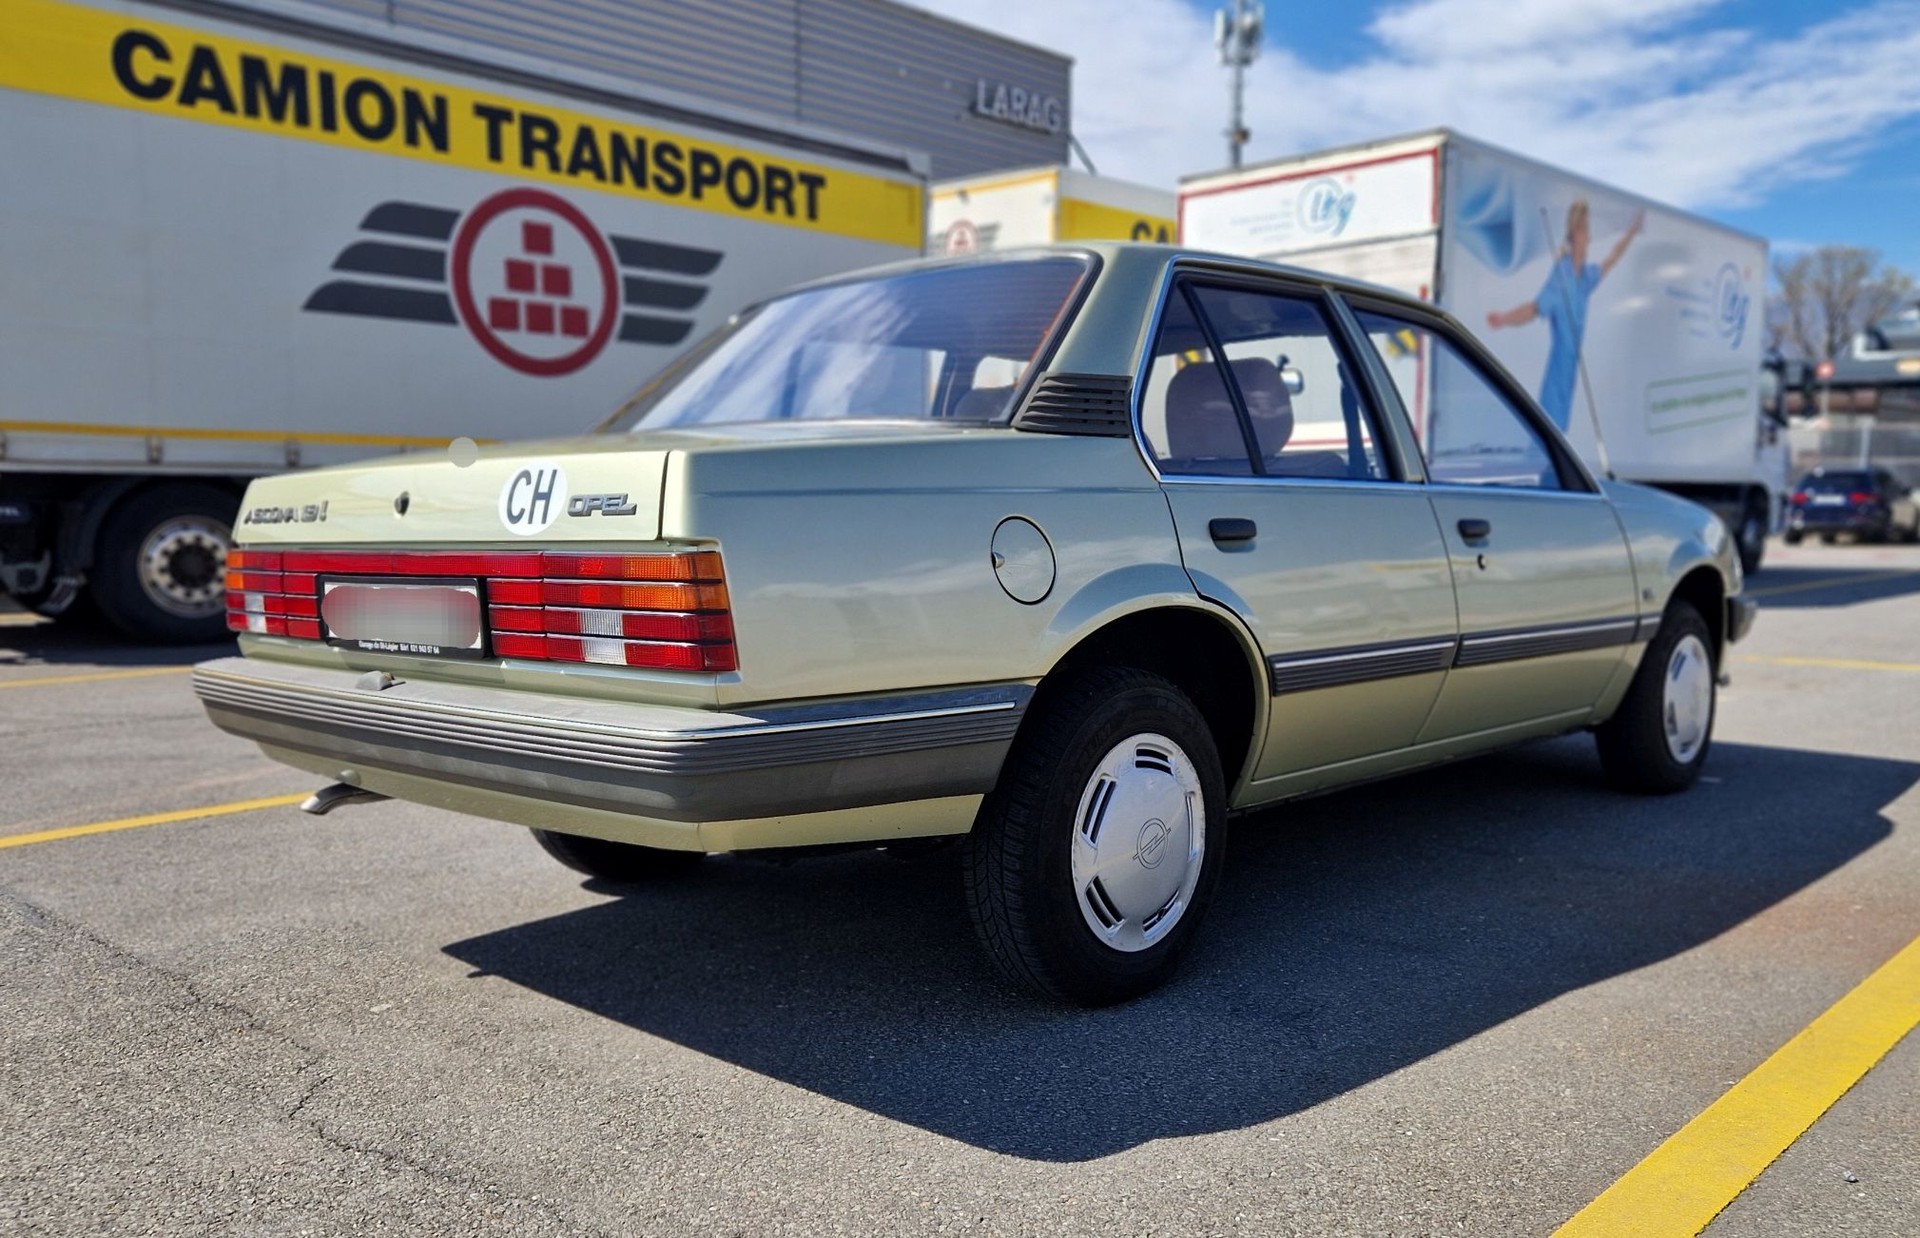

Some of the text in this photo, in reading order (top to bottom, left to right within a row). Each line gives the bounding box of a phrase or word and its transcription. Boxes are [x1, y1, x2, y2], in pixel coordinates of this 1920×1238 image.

[111, 28, 827, 223] CAMION TRANSPORT
[977, 77, 1062, 132] LARAG
[1130, 219, 1175, 245] CA
[506, 468, 559, 525] CH
[567, 492, 637, 518] OPEL
